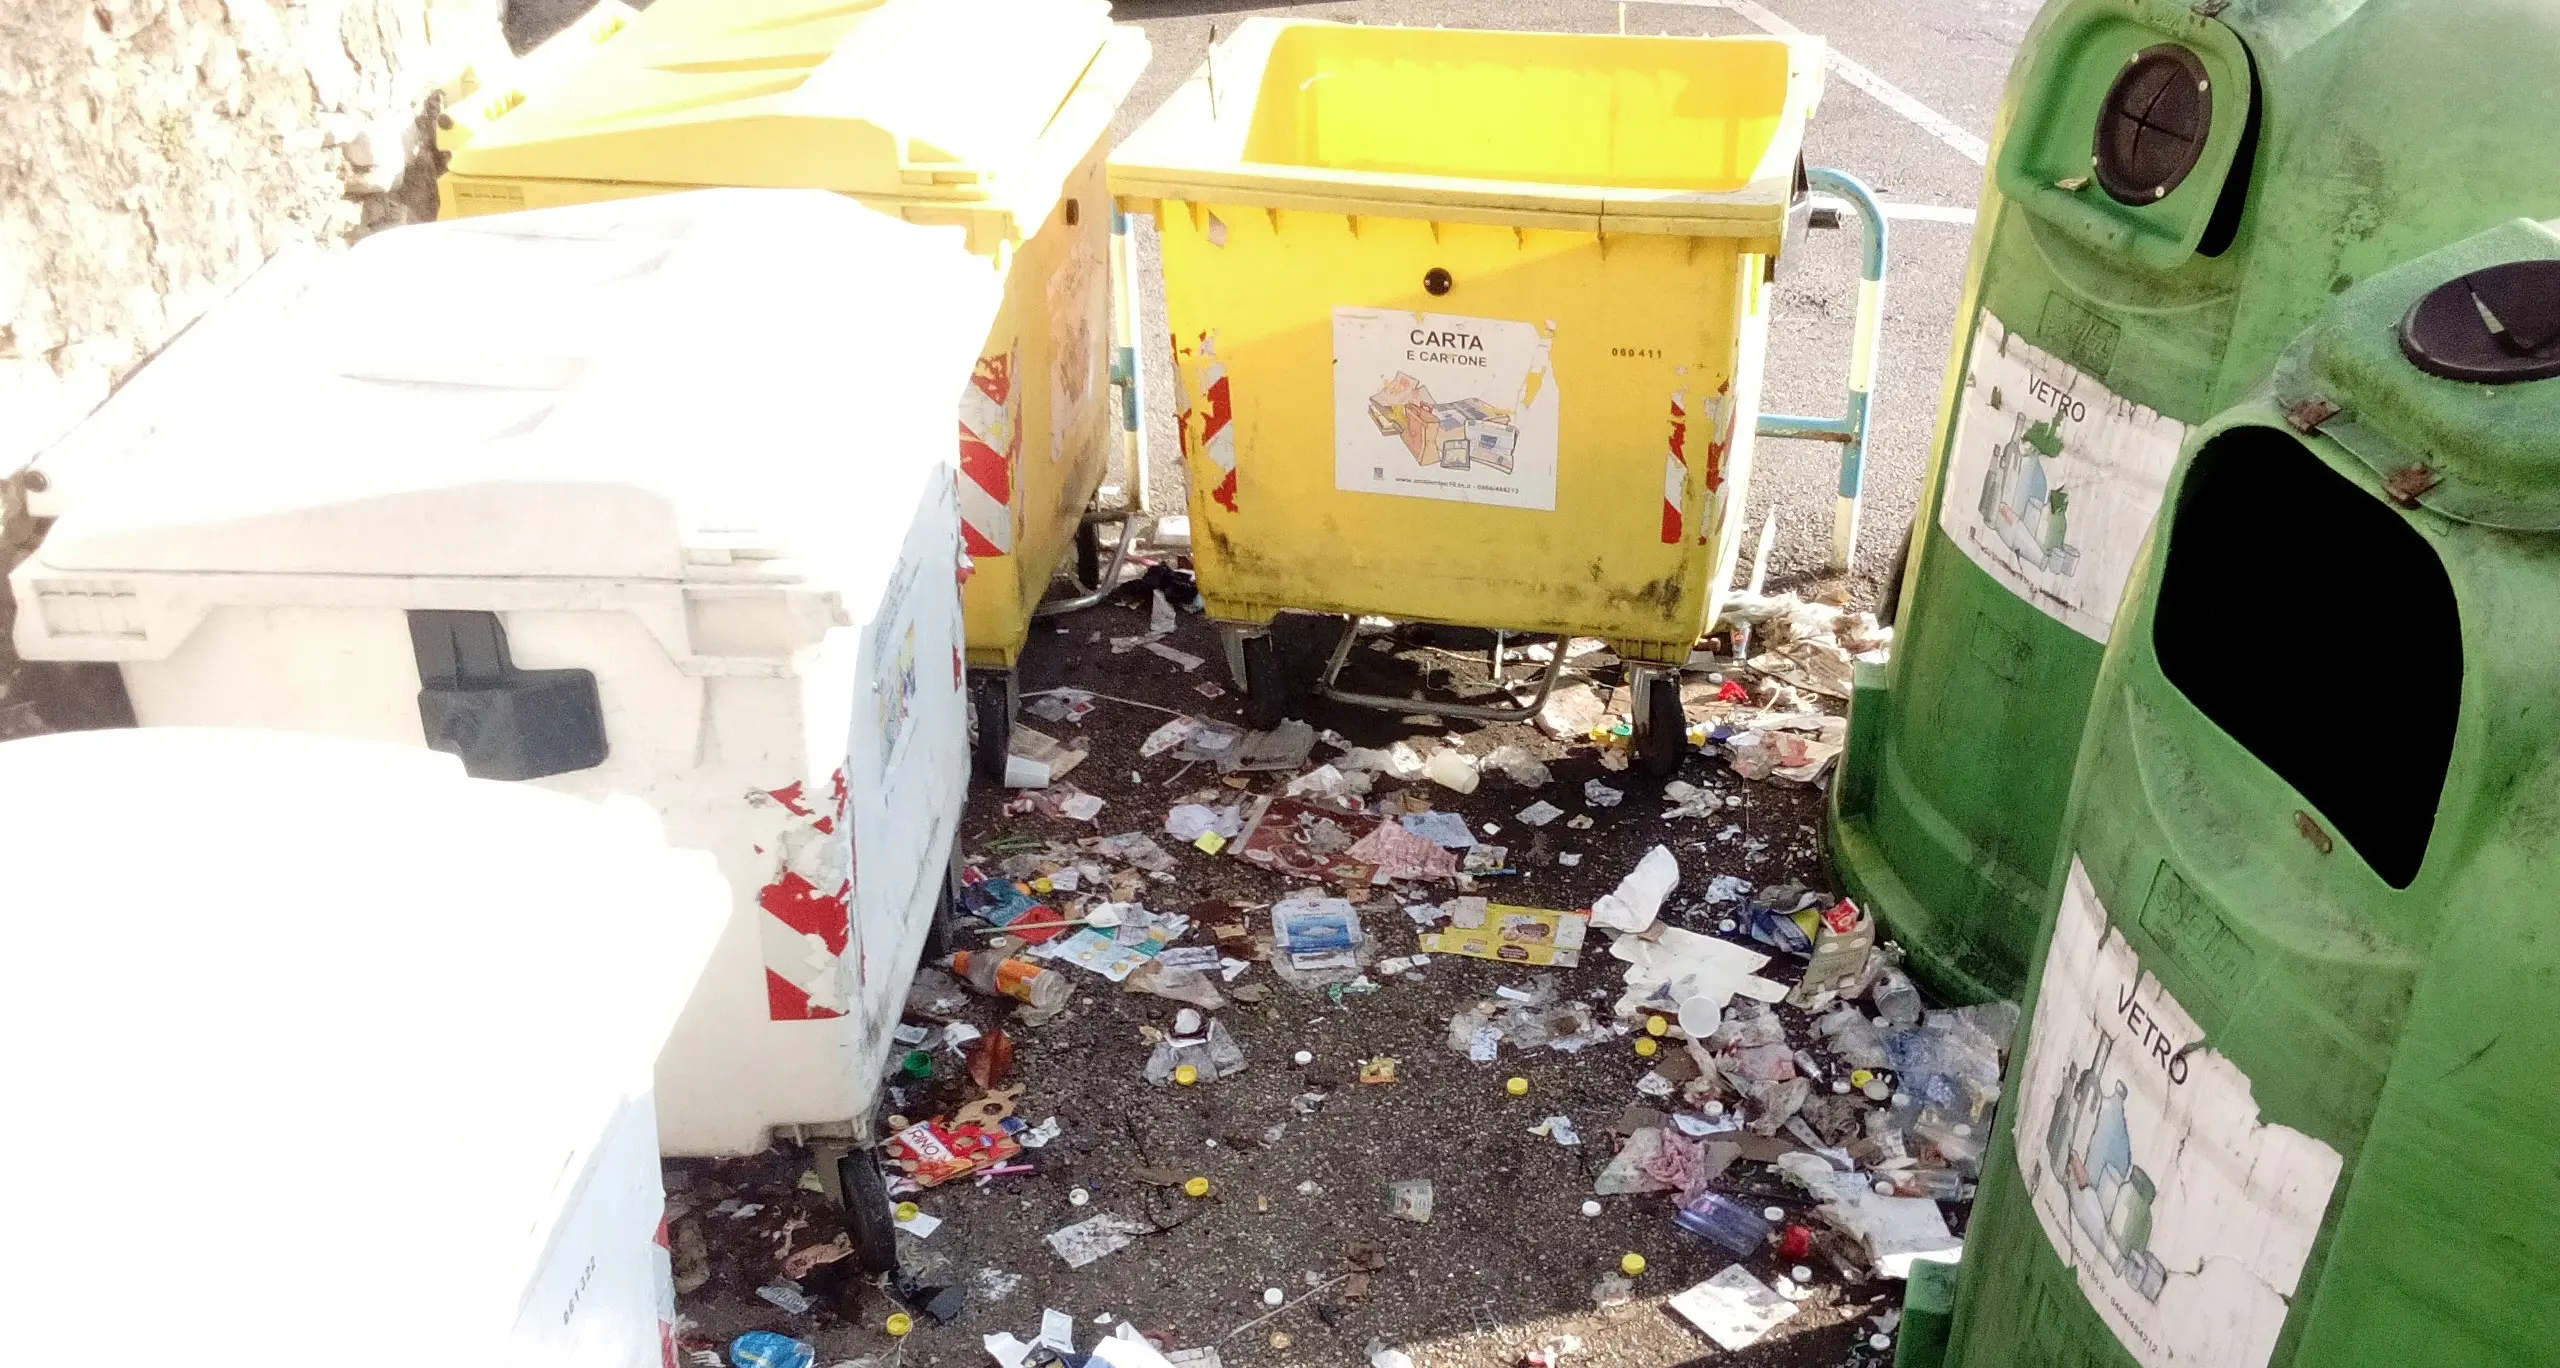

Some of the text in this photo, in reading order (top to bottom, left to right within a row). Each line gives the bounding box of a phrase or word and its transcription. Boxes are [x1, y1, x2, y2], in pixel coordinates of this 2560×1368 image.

[1410, 329, 1483, 351] CARTA
[1407, 350, 1487, 367] E CARTONE
[2029, 374, 2085, 422] VETRO
[2118, 983, 2188, 1085] VETRO
